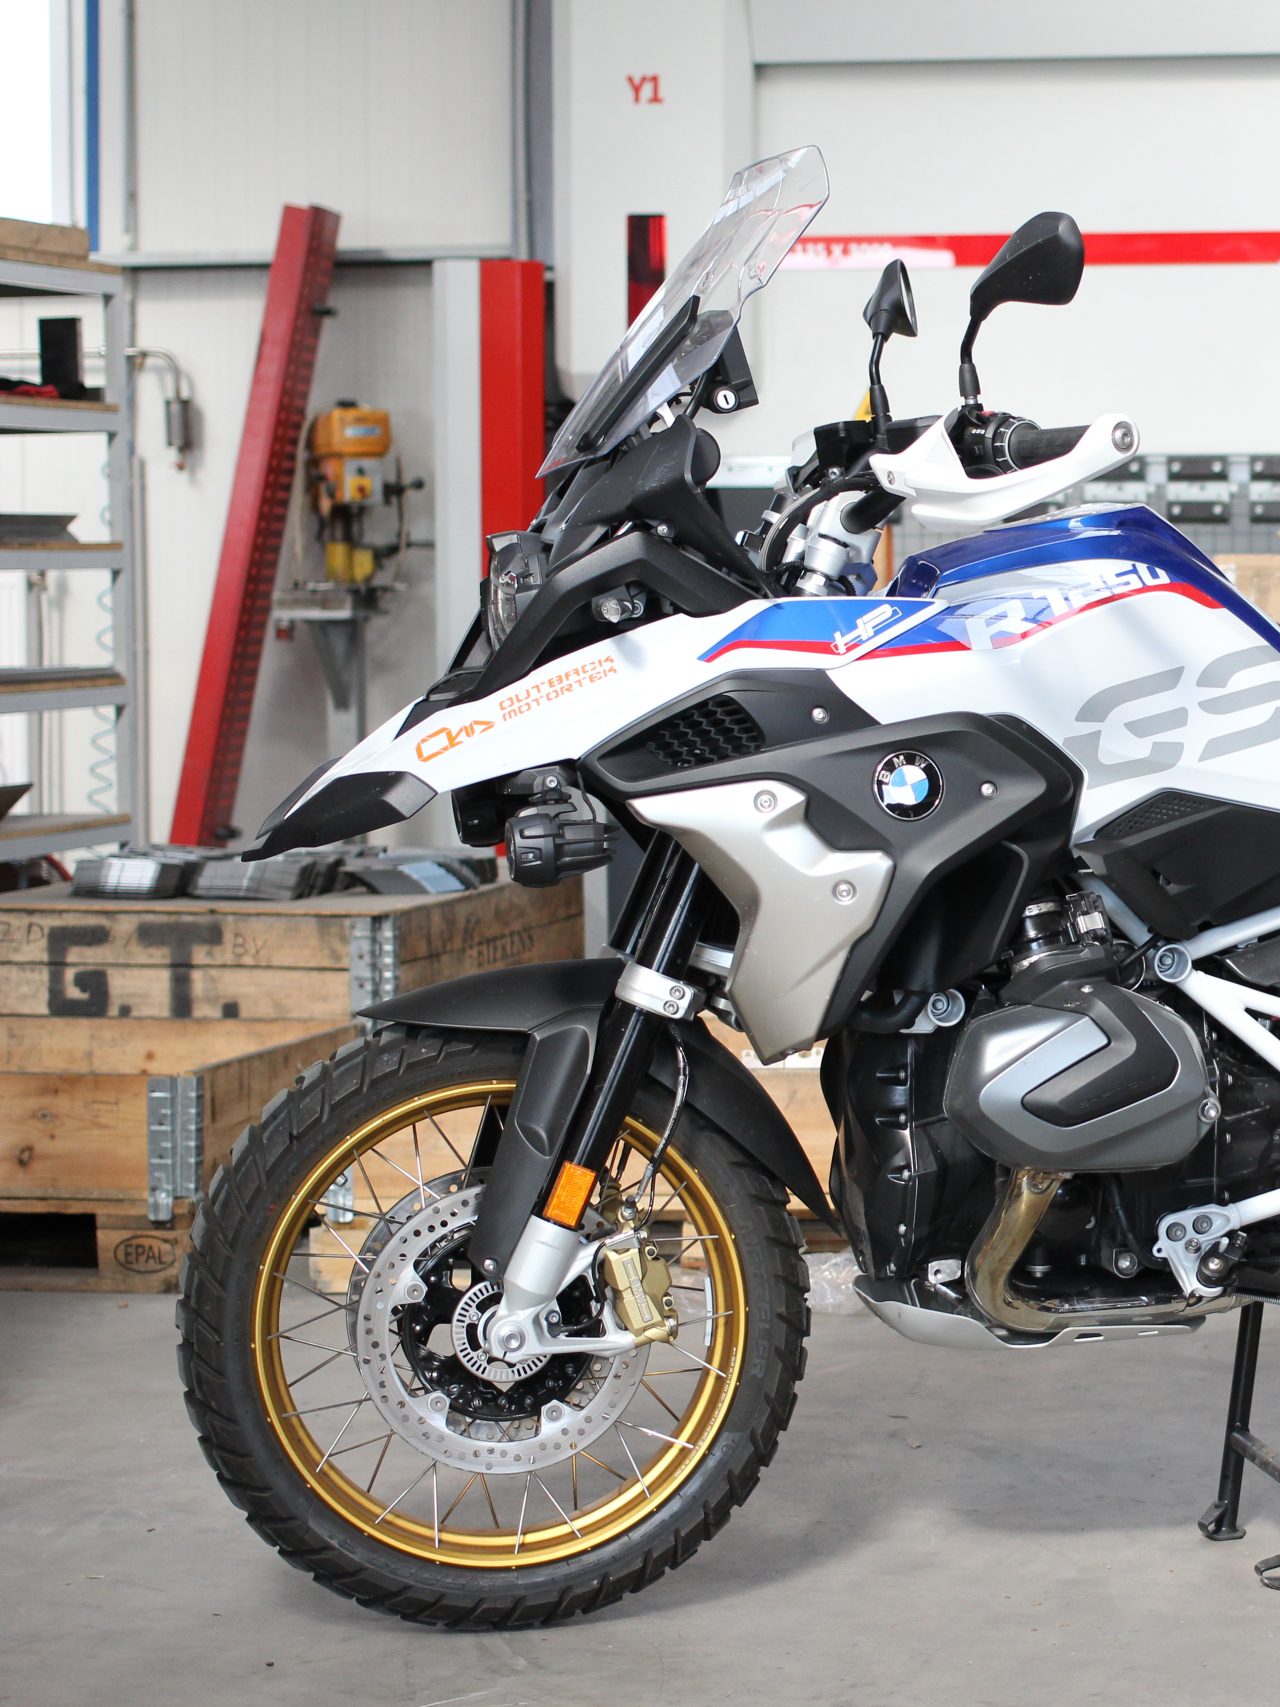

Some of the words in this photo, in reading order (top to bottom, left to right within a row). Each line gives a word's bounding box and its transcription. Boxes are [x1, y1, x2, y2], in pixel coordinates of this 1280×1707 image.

[626, 74, 664, 105] Y1
[832, 604, 895, 655] HP
[499, 655, 615, 712] OUTBACK
[502, 666, 618, 722] MOTORTEK
[879, 754, 929, 783] BMW
[124, 1243, 168, 1265] EPAL
